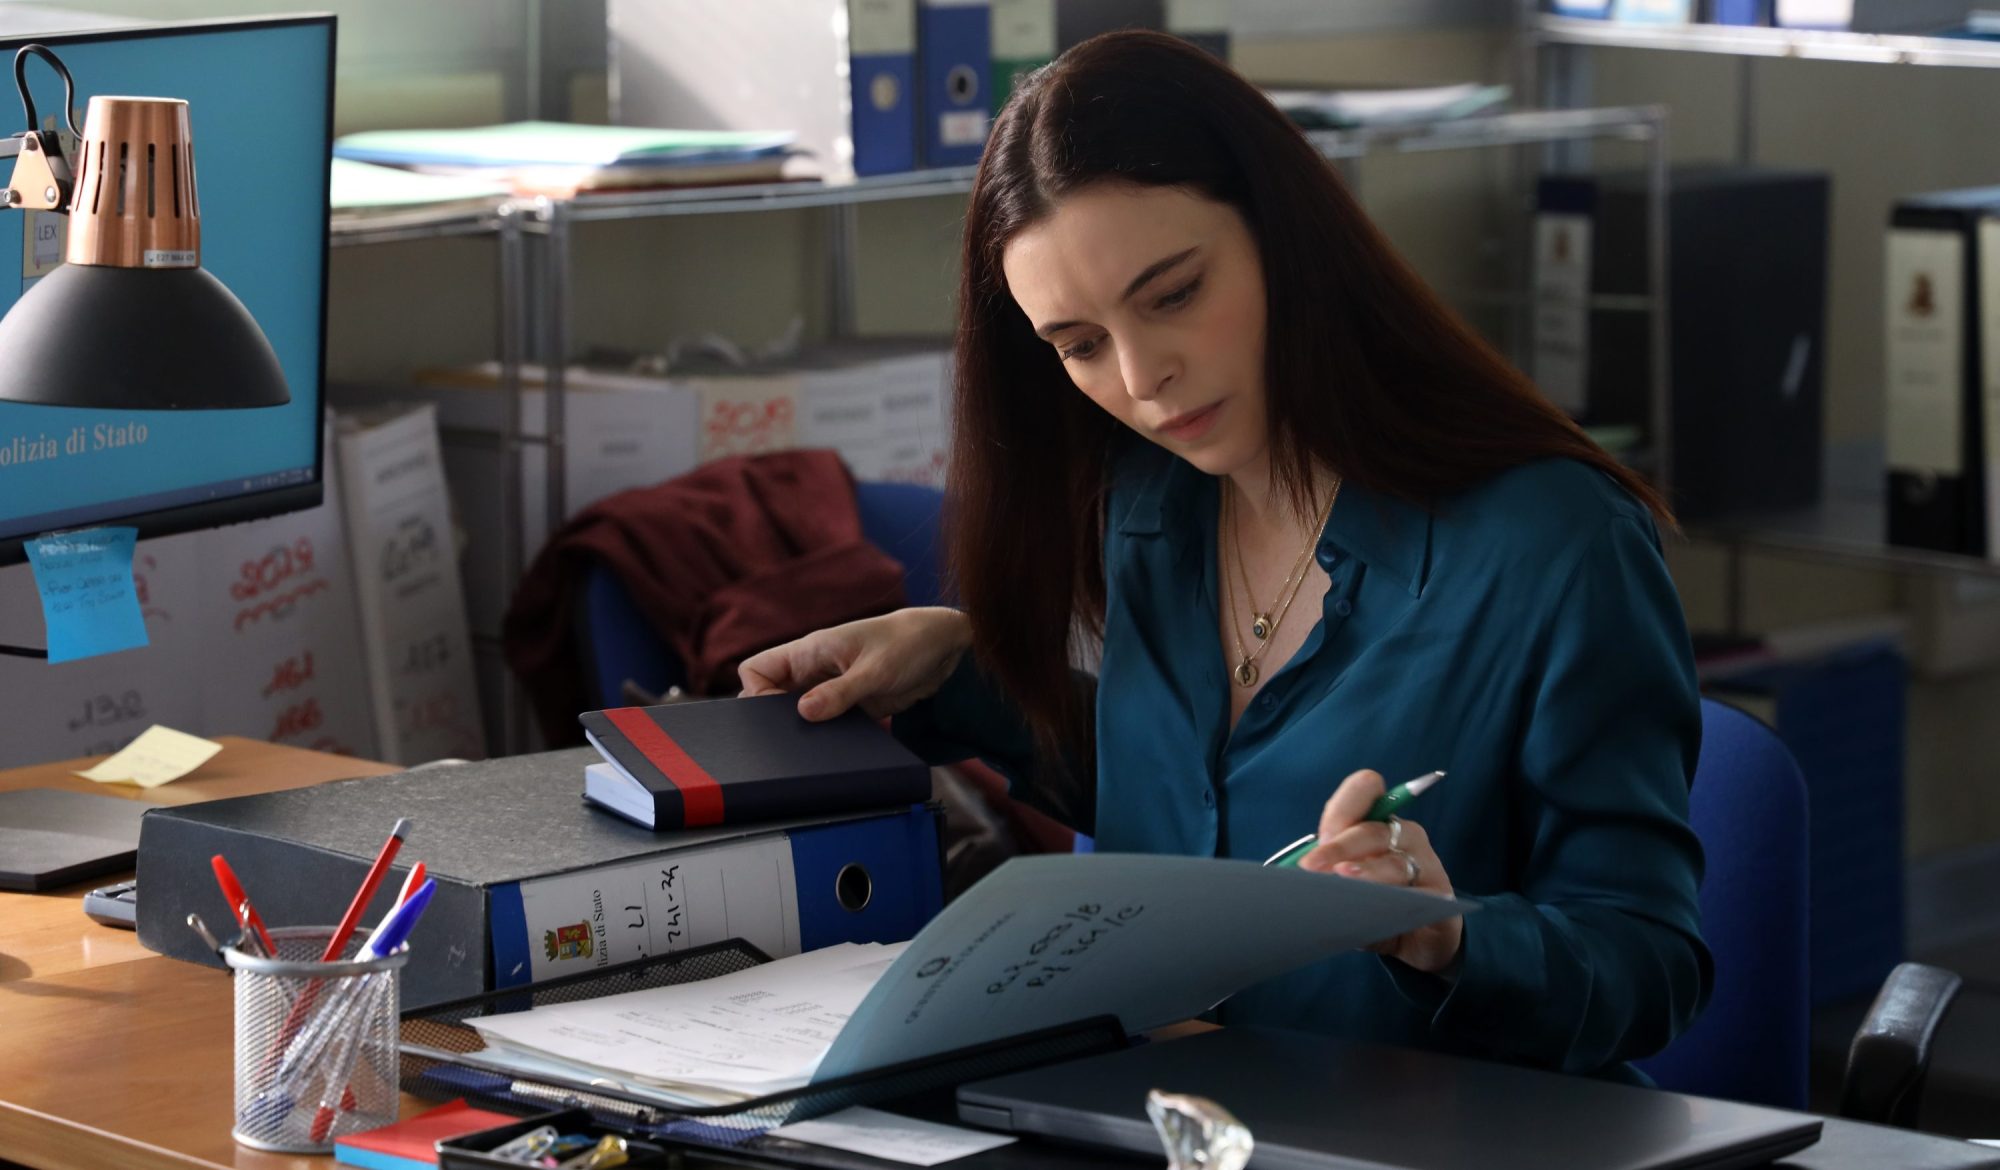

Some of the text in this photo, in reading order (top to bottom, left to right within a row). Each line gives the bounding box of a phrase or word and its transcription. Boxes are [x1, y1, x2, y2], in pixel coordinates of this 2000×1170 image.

[38, 224, 57, 242] LEX
[707, 396, 795, 437] 2019
[65, 426, 86, 455] di
[93, 421, 148, 451] Stato
[592, 889, 608, 969] lizia di Stato
